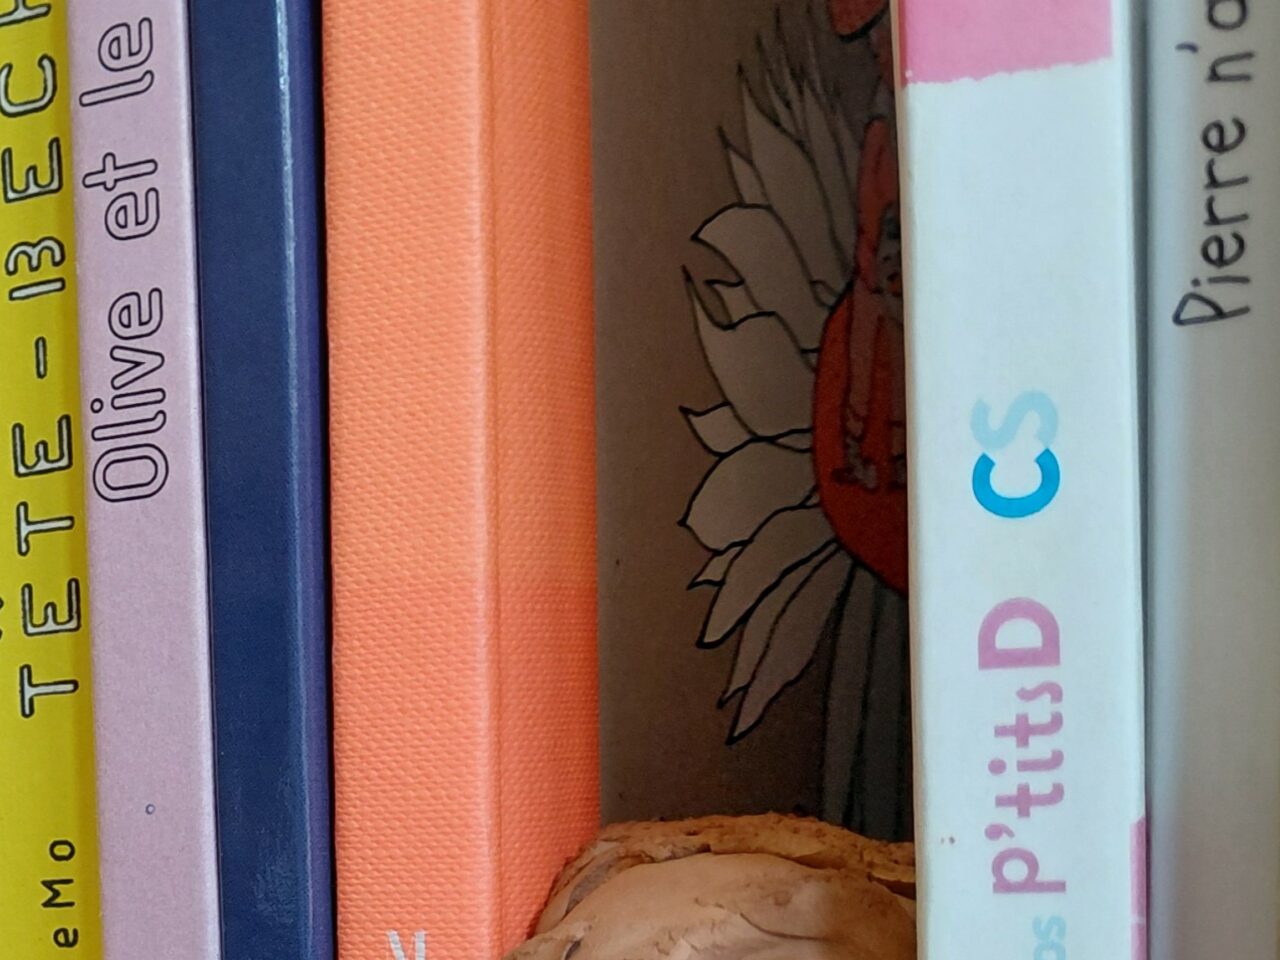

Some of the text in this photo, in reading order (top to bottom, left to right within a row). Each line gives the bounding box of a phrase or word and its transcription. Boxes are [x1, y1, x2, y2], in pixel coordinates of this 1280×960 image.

[78, 17, 170, 503] Olive et le
[1172, 115, 1252, 327] Pierre
